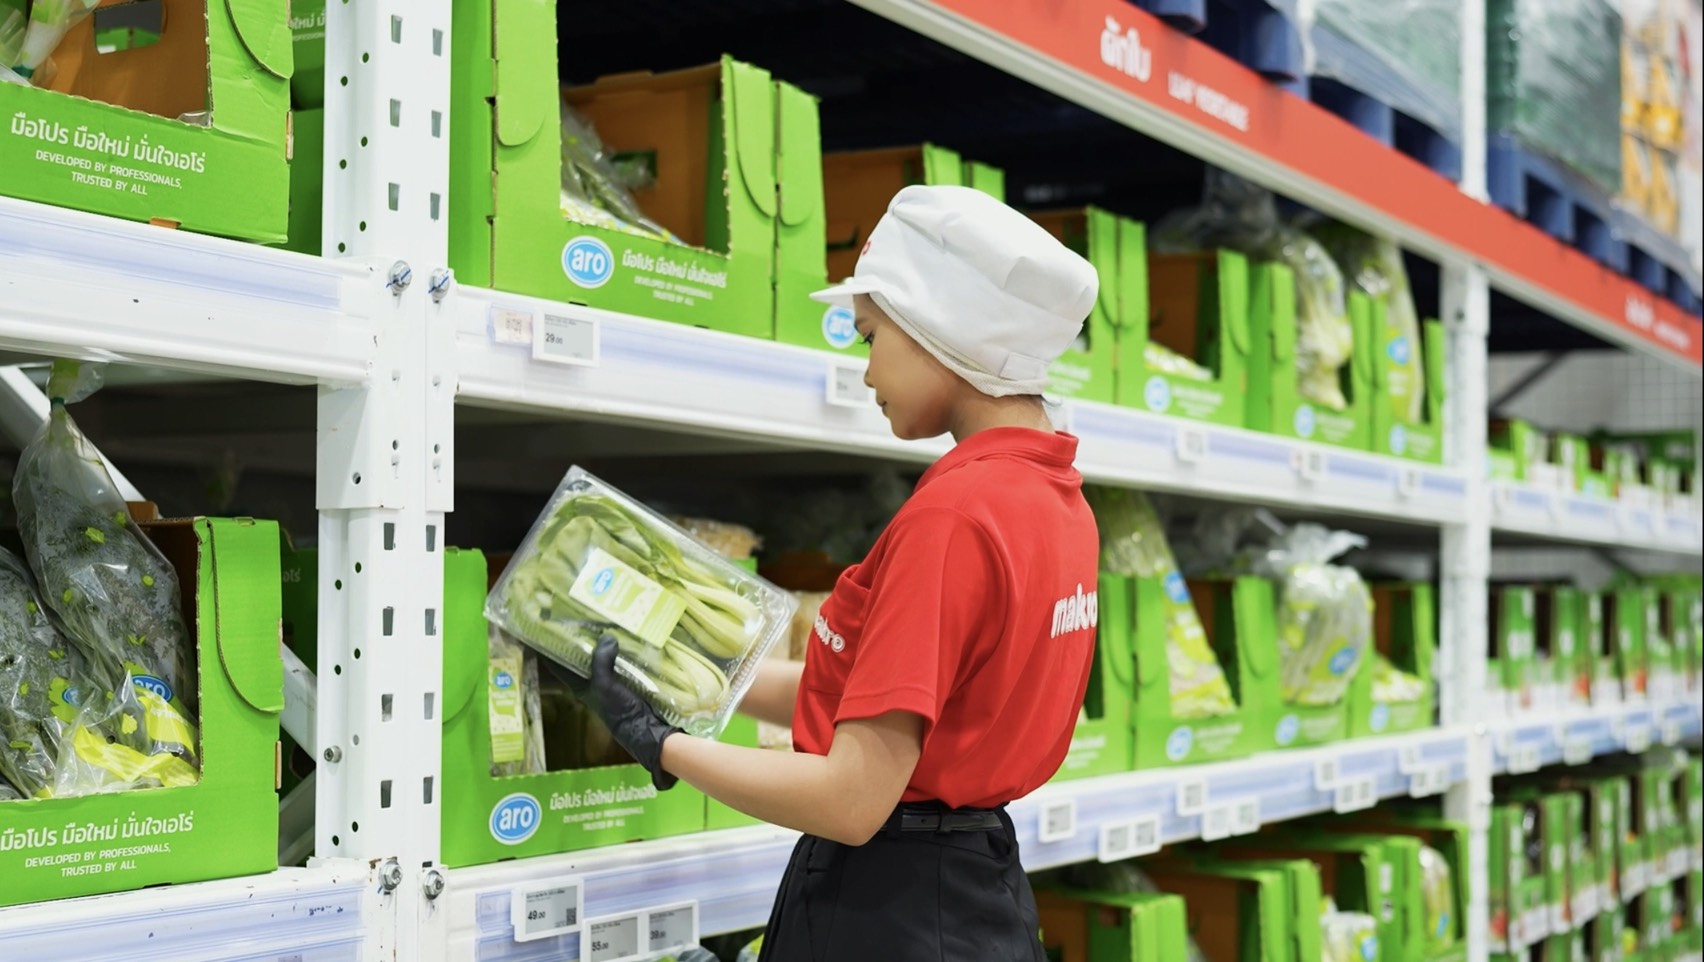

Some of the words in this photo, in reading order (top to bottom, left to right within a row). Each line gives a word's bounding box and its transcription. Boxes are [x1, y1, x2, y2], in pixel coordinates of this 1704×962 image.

[10, 111, 69, 145] มือโปร
[73, 125, 130, 158] มือใหม่
[133, 133, 206, 174] มั่นใจเอโร่
[35, 149, 92, 170] DEVELOPED
[94, 161, 107, 173] BY
[109, 165, 183, 190] PROFESSIONALS,
[71, 171, 112, 188] TRUSTED
[115, 180, 128, 192] BY
[130, 184, 148, 196] ALL
[571, 247, 606, 275] aro
[0, 824, 57, 851] มือโปร
[62, 818, 118, 845] มือใหม่
[122, 810, 194, 839] มั่นใจเอโร่
[500, 806, 534, 831] aro
[25, 852, 81, 868] DEVELOPED
[83, 851, 96, 861] BY
[99, 842, 171, 860] PROFESSIONALS,
[61, 863, 102, 878] TRUSTED
[104, 862, 117, 872] BY
[120, 859, 137, 871] ALL
[527, 910, 546, 920] 49.00
[591, 940, 609, 951] 55.00
